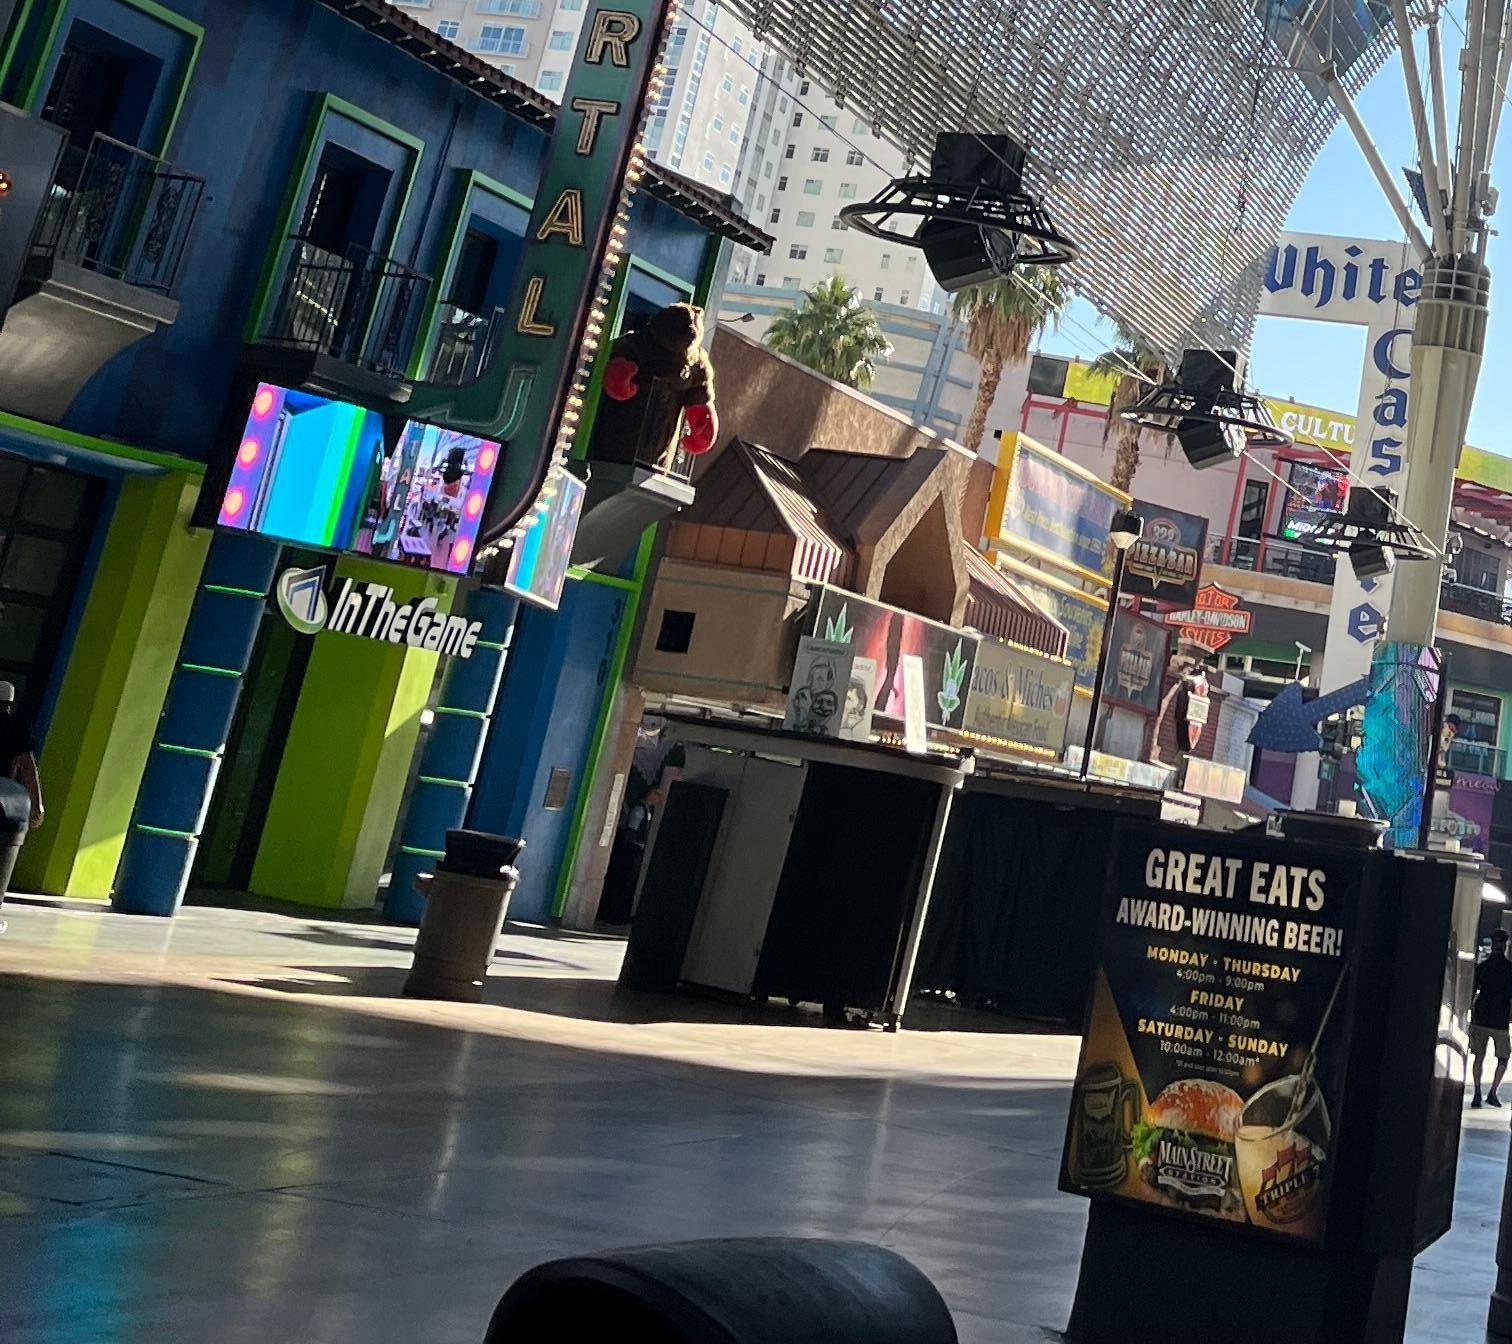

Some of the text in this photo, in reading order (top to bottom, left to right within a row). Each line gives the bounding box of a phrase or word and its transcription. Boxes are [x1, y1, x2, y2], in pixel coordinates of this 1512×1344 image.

[1196, 590, 1231, 607] OTOR
[1145, 848, 1326, 911] GREAT EATS
[1116, 897, 1343, 957] AWARD-WINNING BEER!
[1147, 945, 1209, 967] MONDAY
[1224, 957, 1301, 982] THURSDAY
[1176, 968, 1215, 984] 4:00pm
[1225, 975, 1265, 992] 9:00pm
[1190, 990, 1245, 1012] FRIDAY
[1170, 1004, 1209, 1021] 4:00pm
[1220, 1013, 1261, 1030] 11:00pm
[1137, 1018, 1214, 1044] SATURDAY
[1228, 1034, 1289, 1058] SUNDAY
[1160, 1040, 1203, 1057] 10:00am
